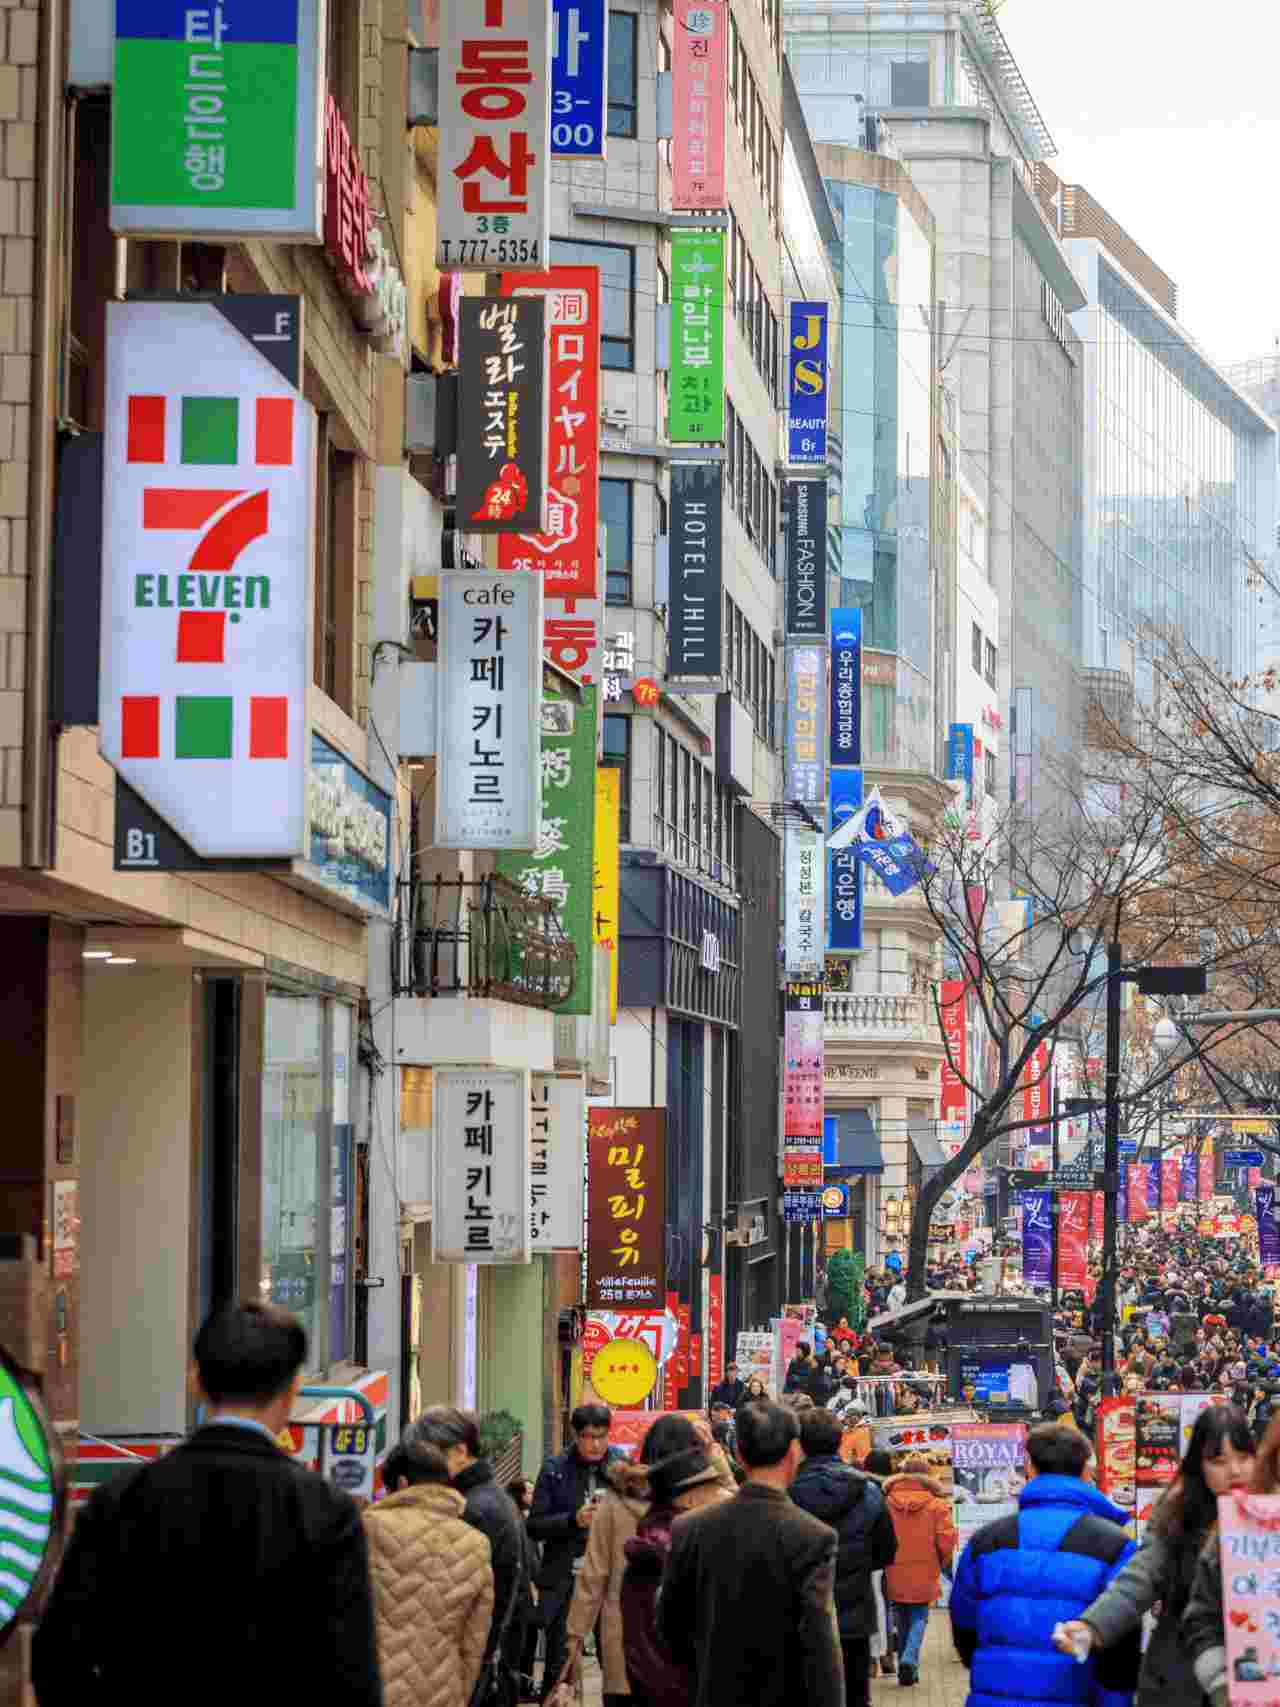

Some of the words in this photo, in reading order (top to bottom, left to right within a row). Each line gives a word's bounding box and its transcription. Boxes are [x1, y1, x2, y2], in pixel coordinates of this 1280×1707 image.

[185, 0, 232, 191] 타드은행
[453, 0, 535, 215] 동산
[483, 391, 507, 458] エステ
[554, 334, 586, 473] ロイヤル
[786, 418, 826, 432] BEAUTY
[683, 503, 707, 579] HOTEL
[797, 485, 808, 536] SAMSUNG
[463, 585, 514, 606] cafe
[797, 539, 815, 617] FASHION
[469, 616, 508, 691] 카페
[683, 594, 705, 663] JHILL
[468, 704, 504, 803] 키노르
[128, 830, 156, 858] B1
[836, 849, 856, 921] 리은행
[465, 1089, 495, 1156] 카페
[464, 1165, 494, 1253] 키노르
